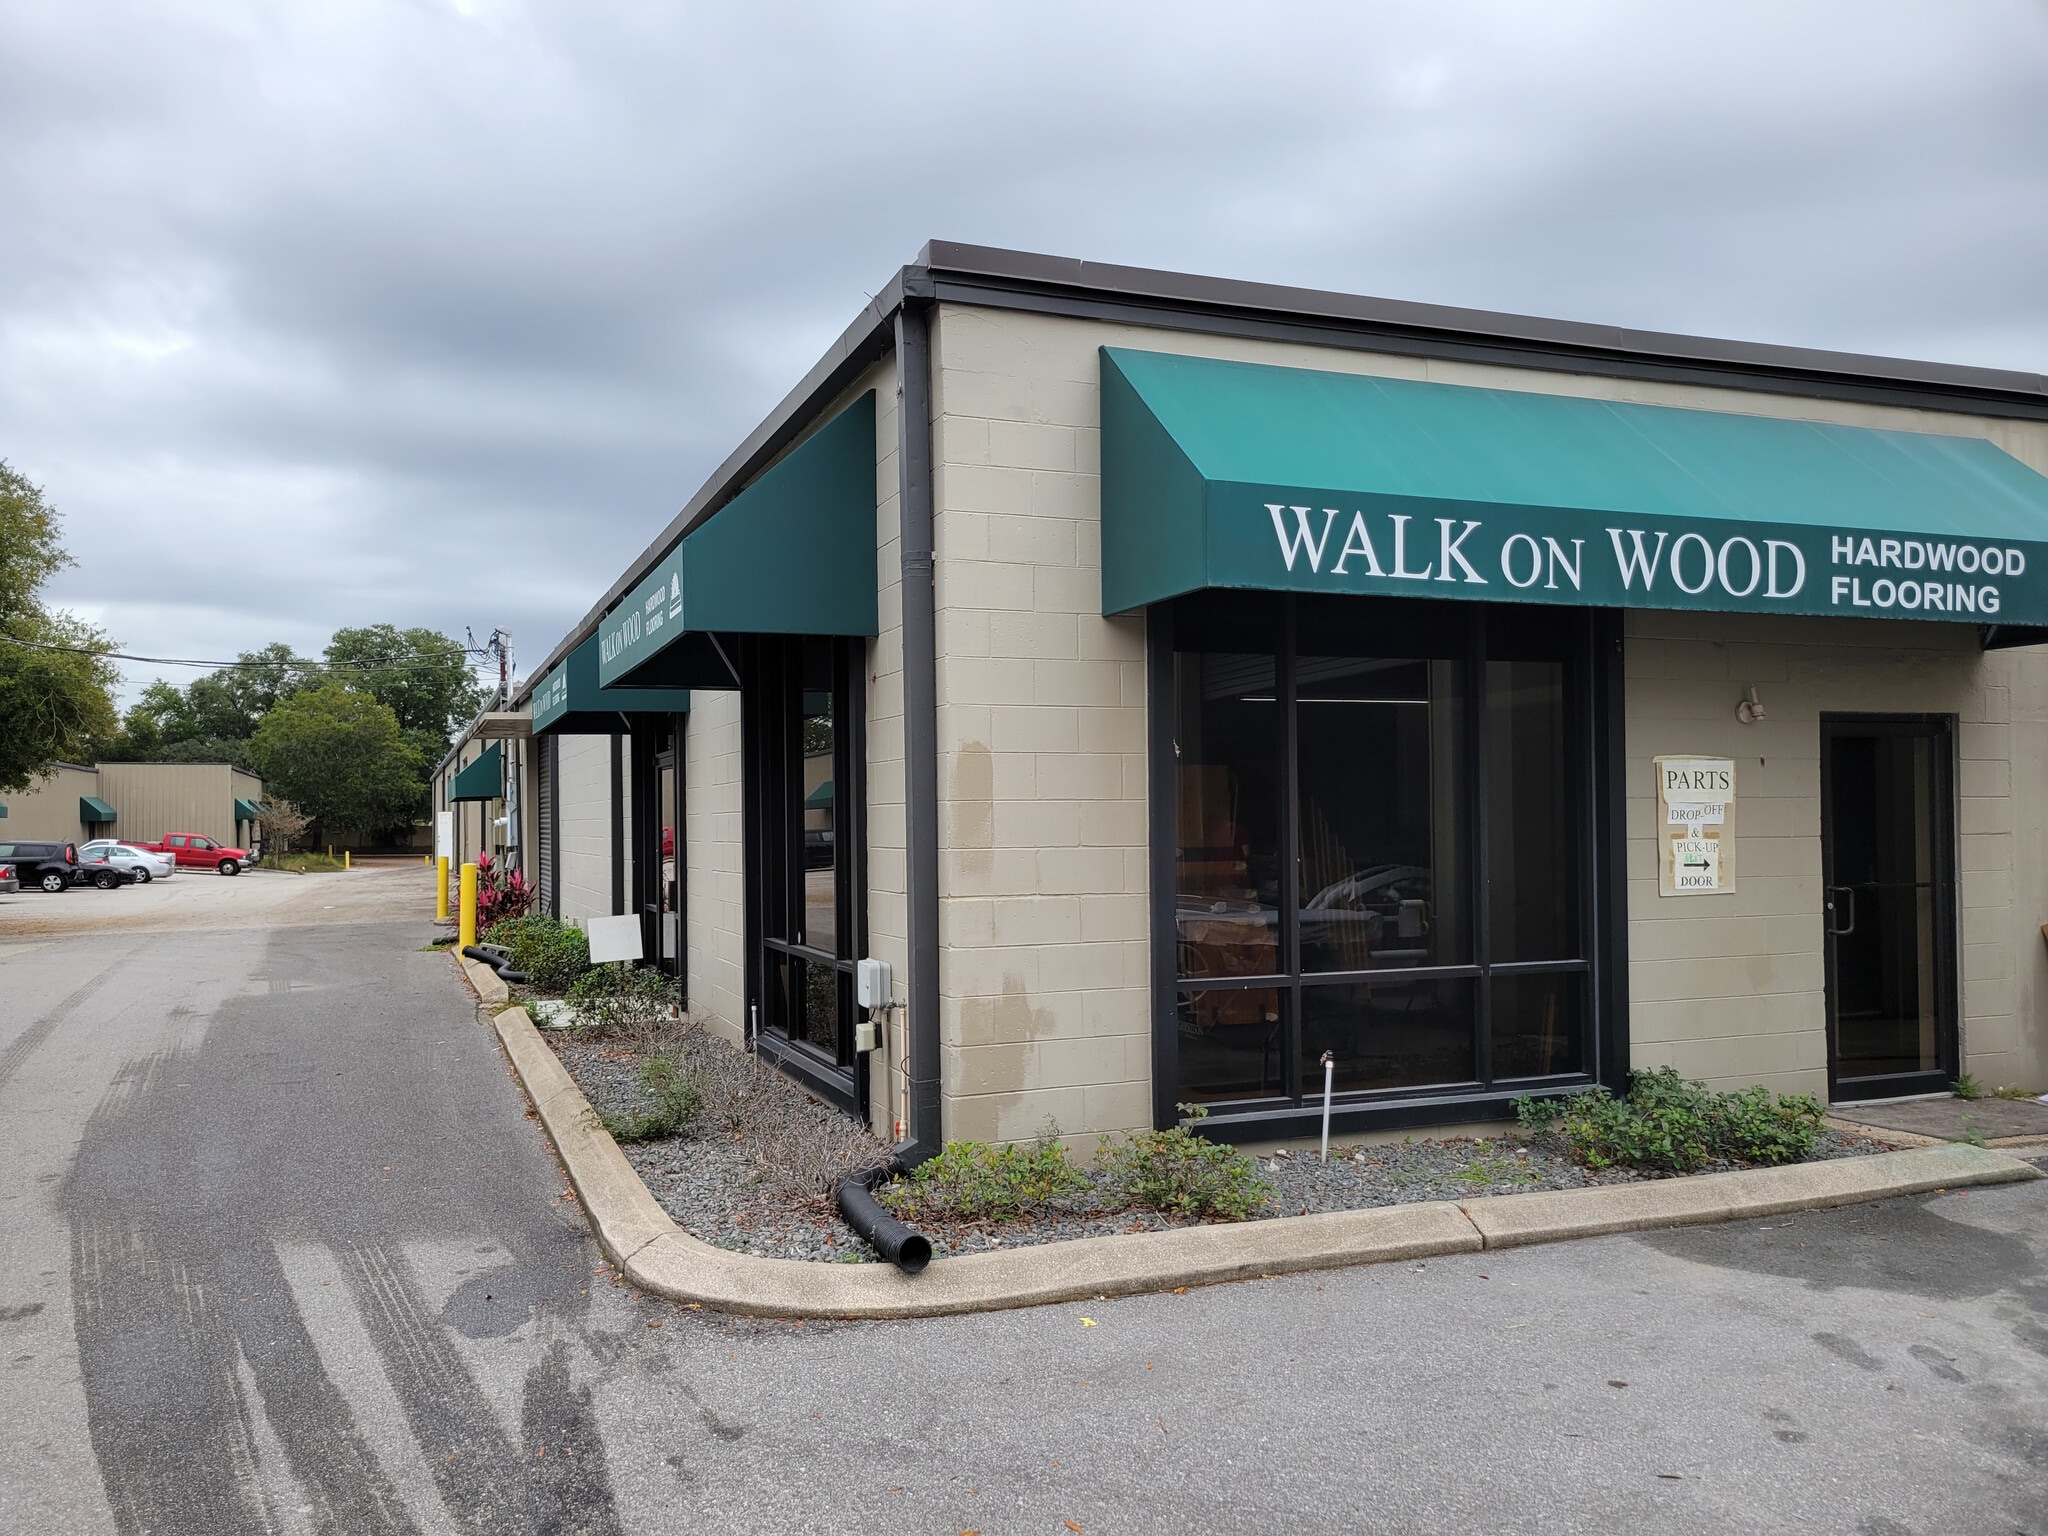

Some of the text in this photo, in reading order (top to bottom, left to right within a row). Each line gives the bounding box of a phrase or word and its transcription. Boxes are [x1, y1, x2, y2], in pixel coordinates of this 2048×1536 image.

[1264, 503, 1806, 598] WALK ON WOOD
[1831, 535, 2026, 576] HARDWOOD
[1831, 576, 2000, 614] FLOORING
[601, 631, 617, 666] WALK
[622, 610, 641, 650] WOOD
[1666, 770, 1730, 791] PARTS
[1677, 841, 1719, 853] PICK-UP
[1691, 828, 1700, 838] &
[1681, 876, 1713, 887] DOOR
